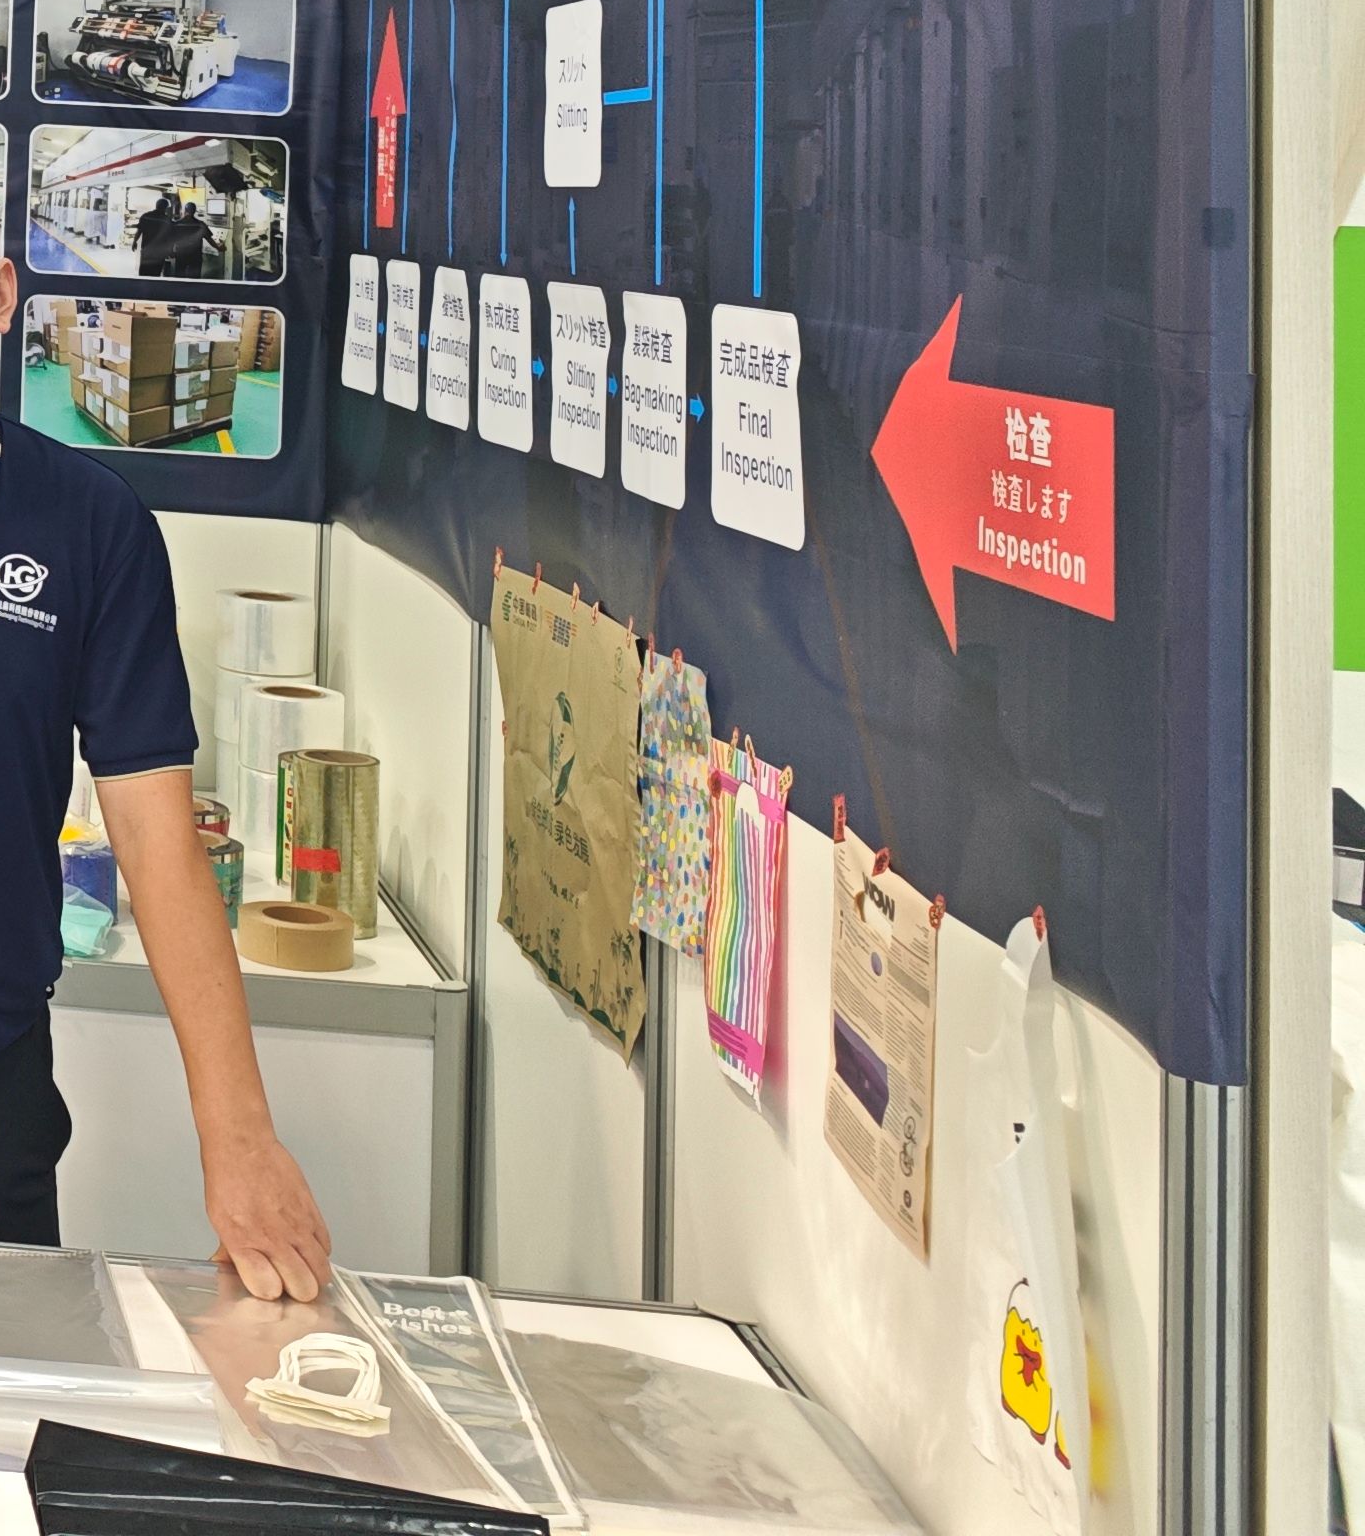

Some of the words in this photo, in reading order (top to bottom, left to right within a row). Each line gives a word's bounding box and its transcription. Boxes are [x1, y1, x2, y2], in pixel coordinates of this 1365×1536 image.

[556, 314, 607, 349] スリット検査
[632, 323, 673, 364] 製袋検査
[491, 345, 517, 379] Curing
[566, 360, 596, 397] Slitting
[719, 339, 792, 388] 完成品検査
[484, 377, 528, 410] Inspection
[557, 395, 601, 432] Inspection
[624, 374, 683, 424] Bag-making
[627, 416, 677, 458] Inspection
[738, 401, 773, 440] Final
[721, 442, 793, 492] Inspection
[991, 469, 1072, 524] 検査します
[978, 515, 1086, 585] Inspection
[383, 1302, 446, 1321] Best
